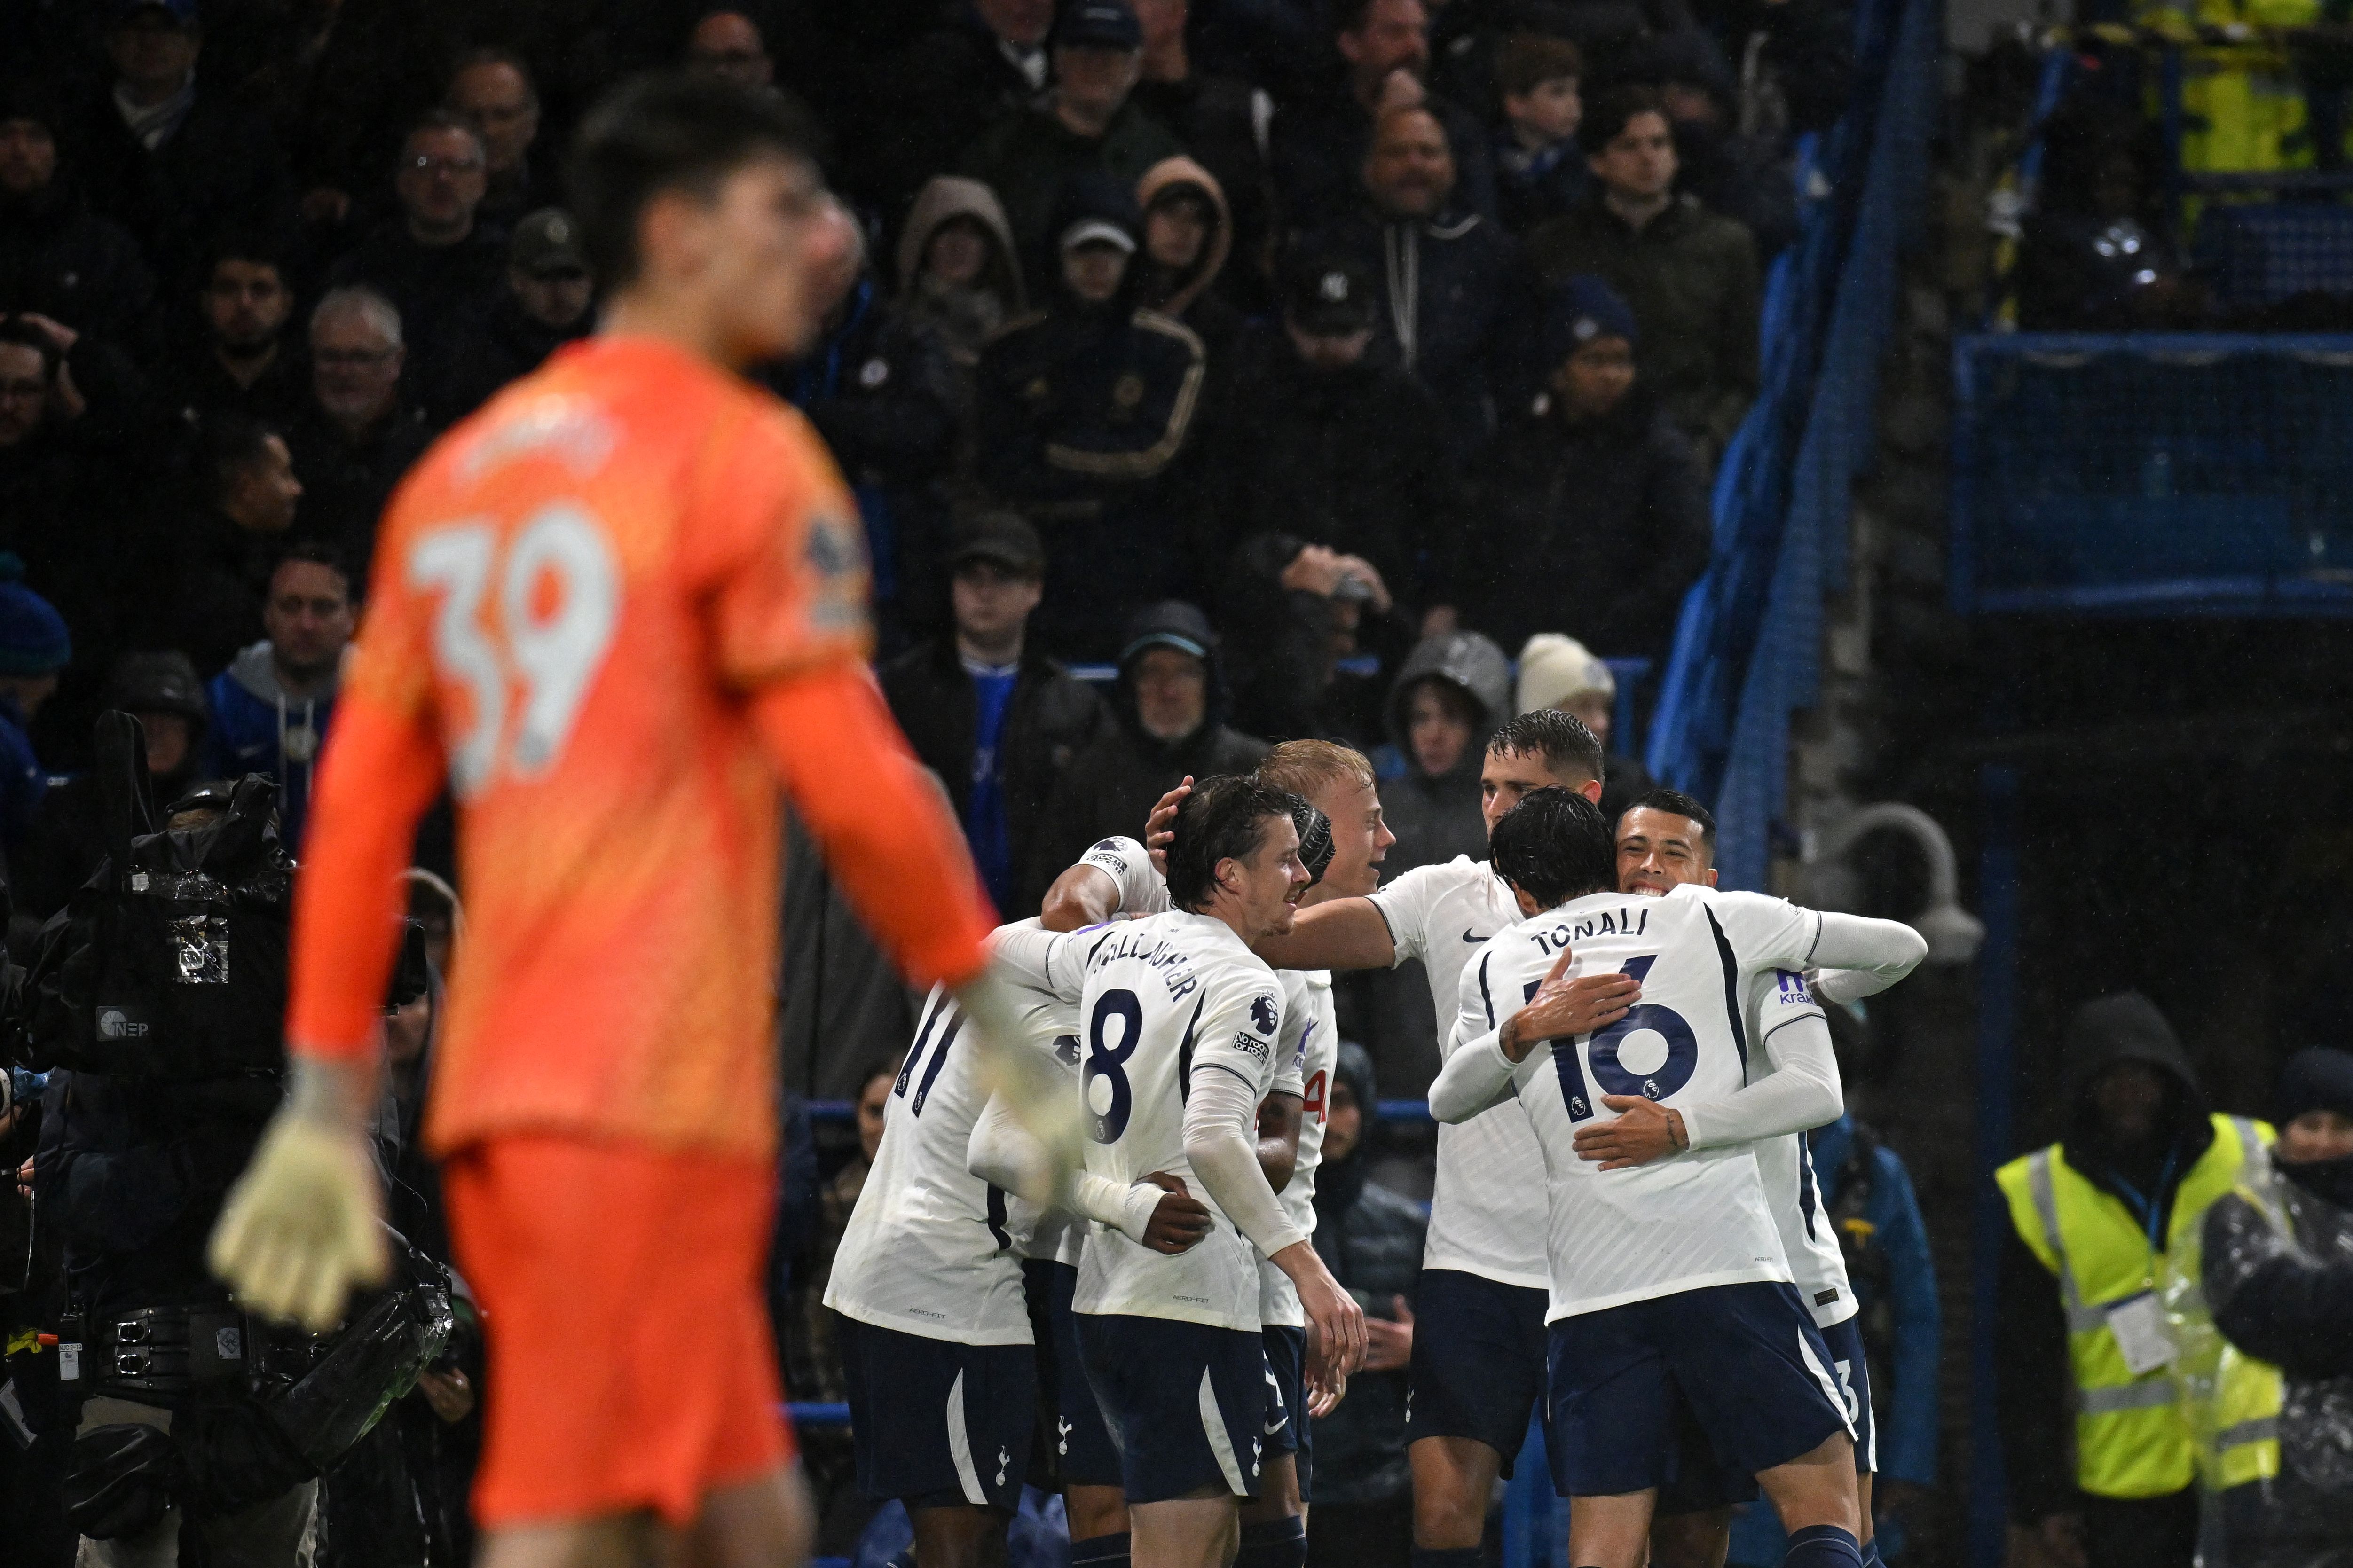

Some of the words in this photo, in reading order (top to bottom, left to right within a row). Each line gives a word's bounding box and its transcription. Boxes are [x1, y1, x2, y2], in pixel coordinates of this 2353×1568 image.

[410, 504, 618, 798] 39
[1531, 908, 1648, 956] TONALI
[116, 1023, 148, 1036] NEP
[1235, 1032, 1248, 1043] No
[1232, 1039, 1246, 1051] for
[1083, 989, 1142, 1144] 8
[1173, 1295, 1209, 1303] AERO-FIT
[909, 1308, 946, 1319] AERO-FIT
